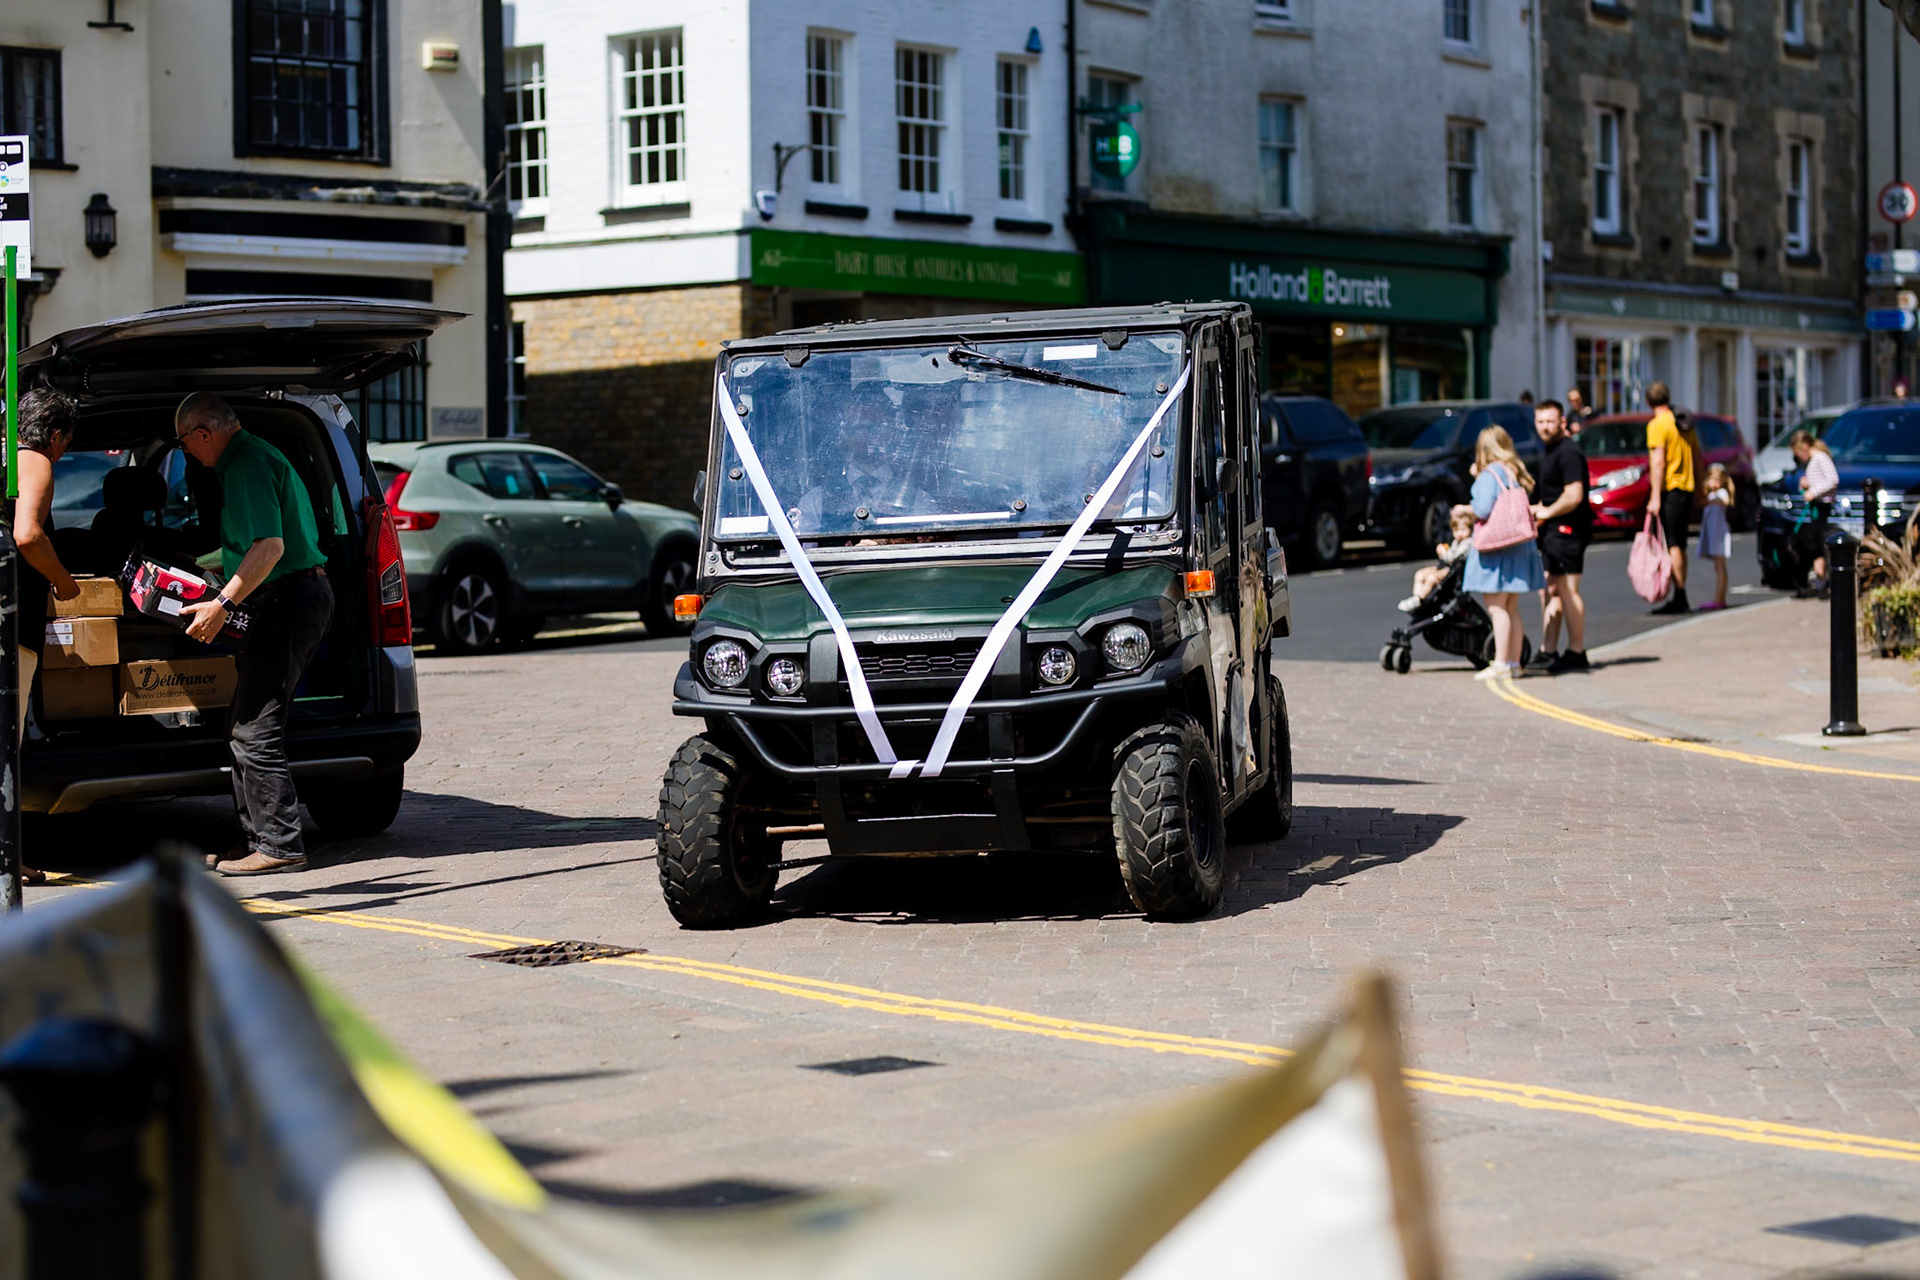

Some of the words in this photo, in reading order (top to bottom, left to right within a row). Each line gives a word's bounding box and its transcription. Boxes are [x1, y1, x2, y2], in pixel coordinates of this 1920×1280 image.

[1230, 261, 1308, 302] Holland
[1323, 267, 1391, 309] Barrett
[876, 629, 954, 642] Kawasaki
[136, 665, 216, 691] Délifrance
